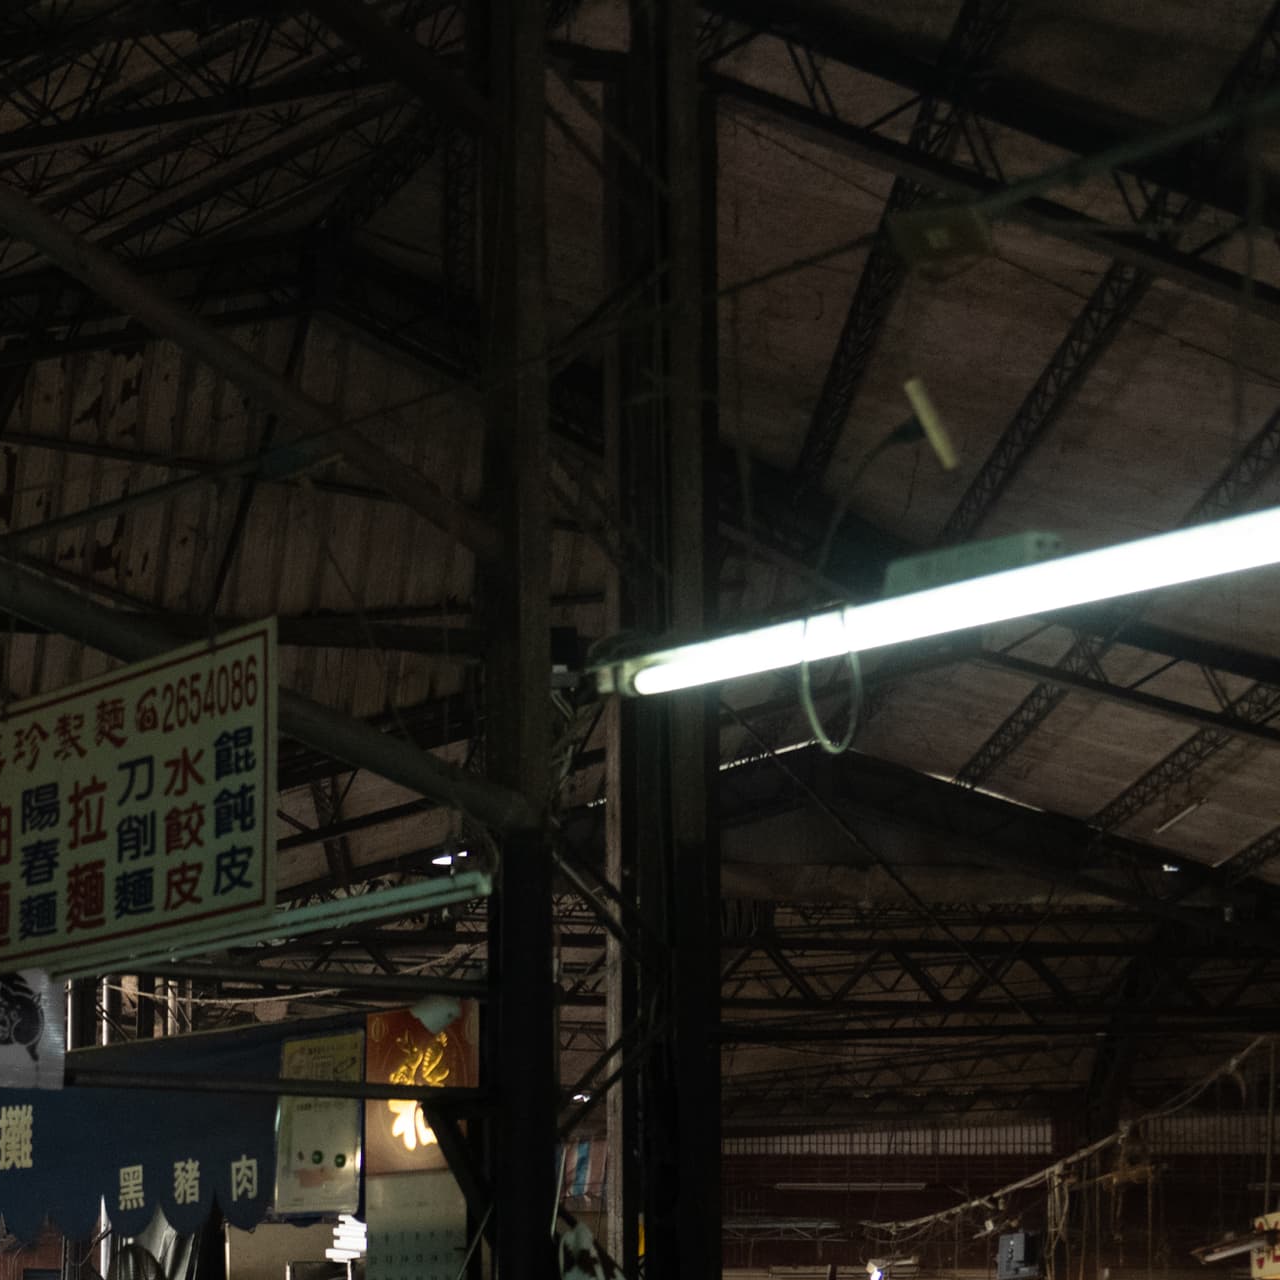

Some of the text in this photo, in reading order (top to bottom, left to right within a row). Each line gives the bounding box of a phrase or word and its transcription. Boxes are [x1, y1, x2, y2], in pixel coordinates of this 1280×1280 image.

[162, 655, 257, 733] 2654086
[19, 783, 60, 940] 陽春麵
[66, 776, 107, 933] 拉麵
[115, 756, 156, 919] 刀削麵
[164, 747, 204, 911] 水餃皮
[213, 726, 256, 896] 餛飩皮
[118, 1154, 258, 1211] 黑豬肉
